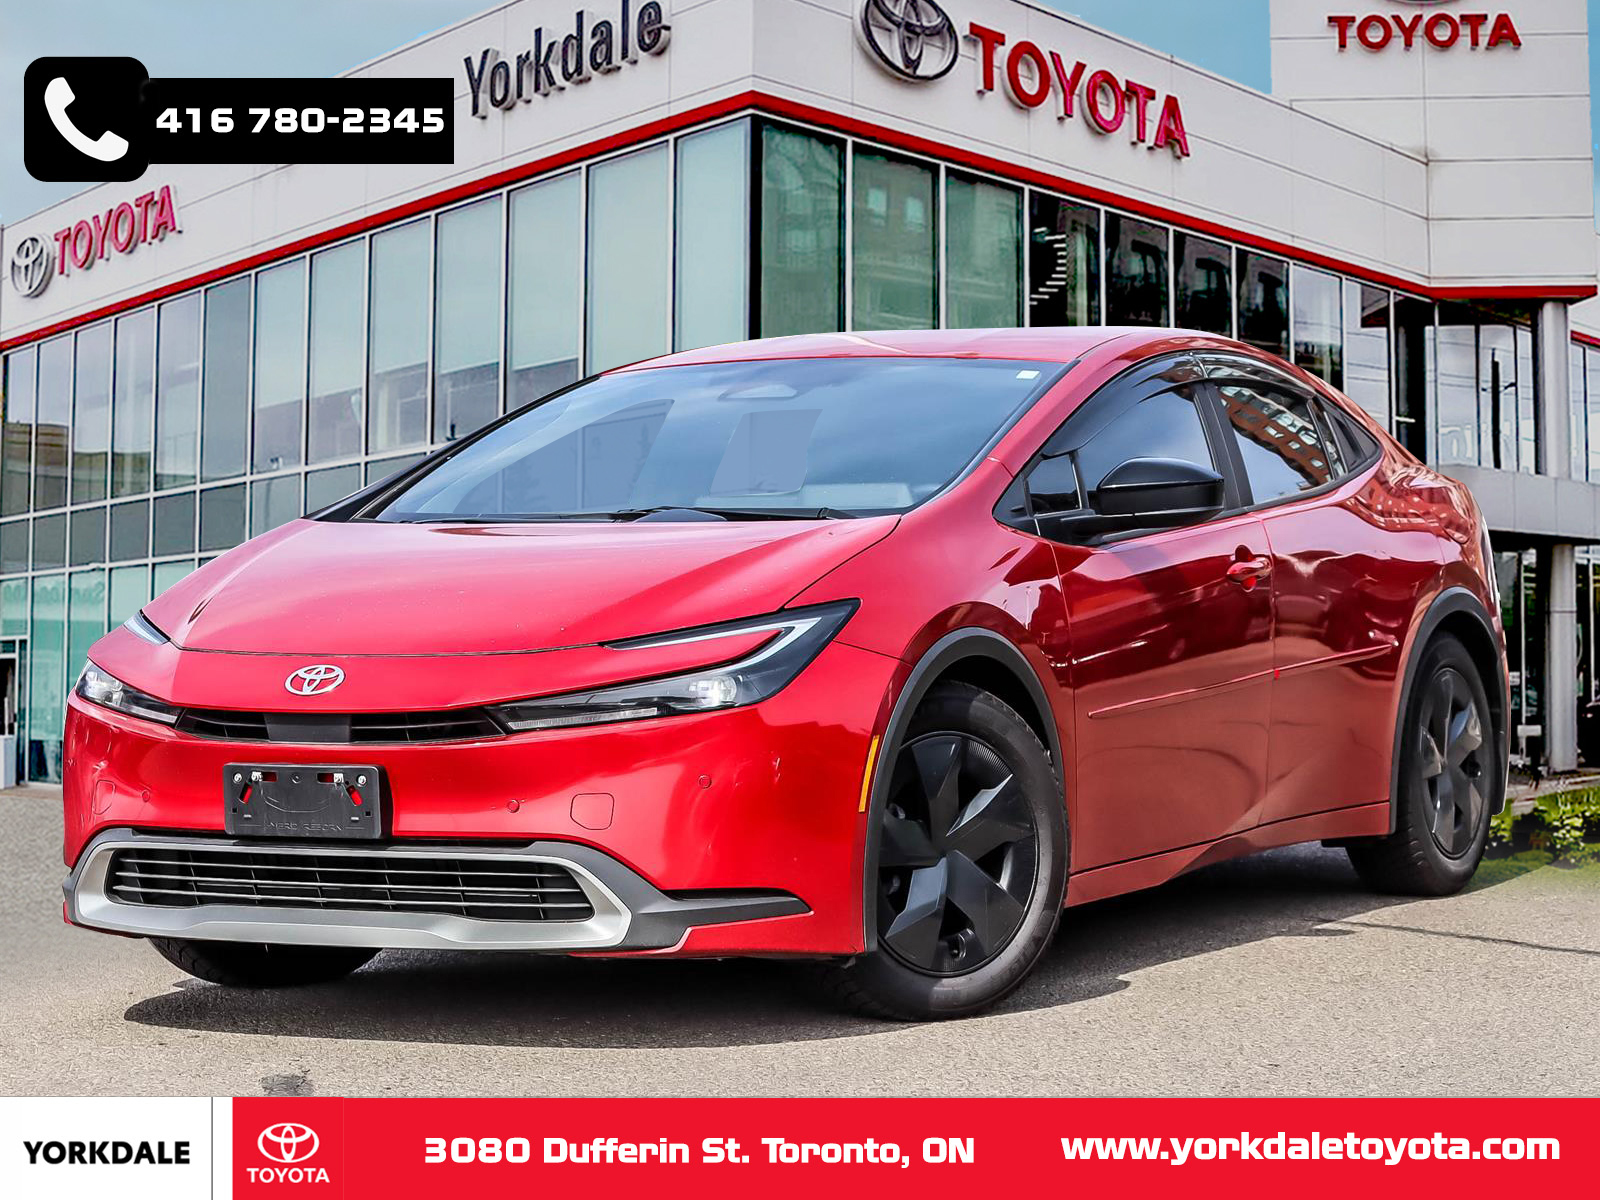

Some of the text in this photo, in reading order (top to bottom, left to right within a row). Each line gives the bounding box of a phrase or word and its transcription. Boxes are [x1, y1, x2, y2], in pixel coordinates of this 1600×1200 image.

[464, 0, 671, 117] Yorkdale
[1327, 13, 1522, 50] TOYOTA
[968, 21, 1190, 157] TOYOTA
[54, 185, 177, 275] TOYOTA
